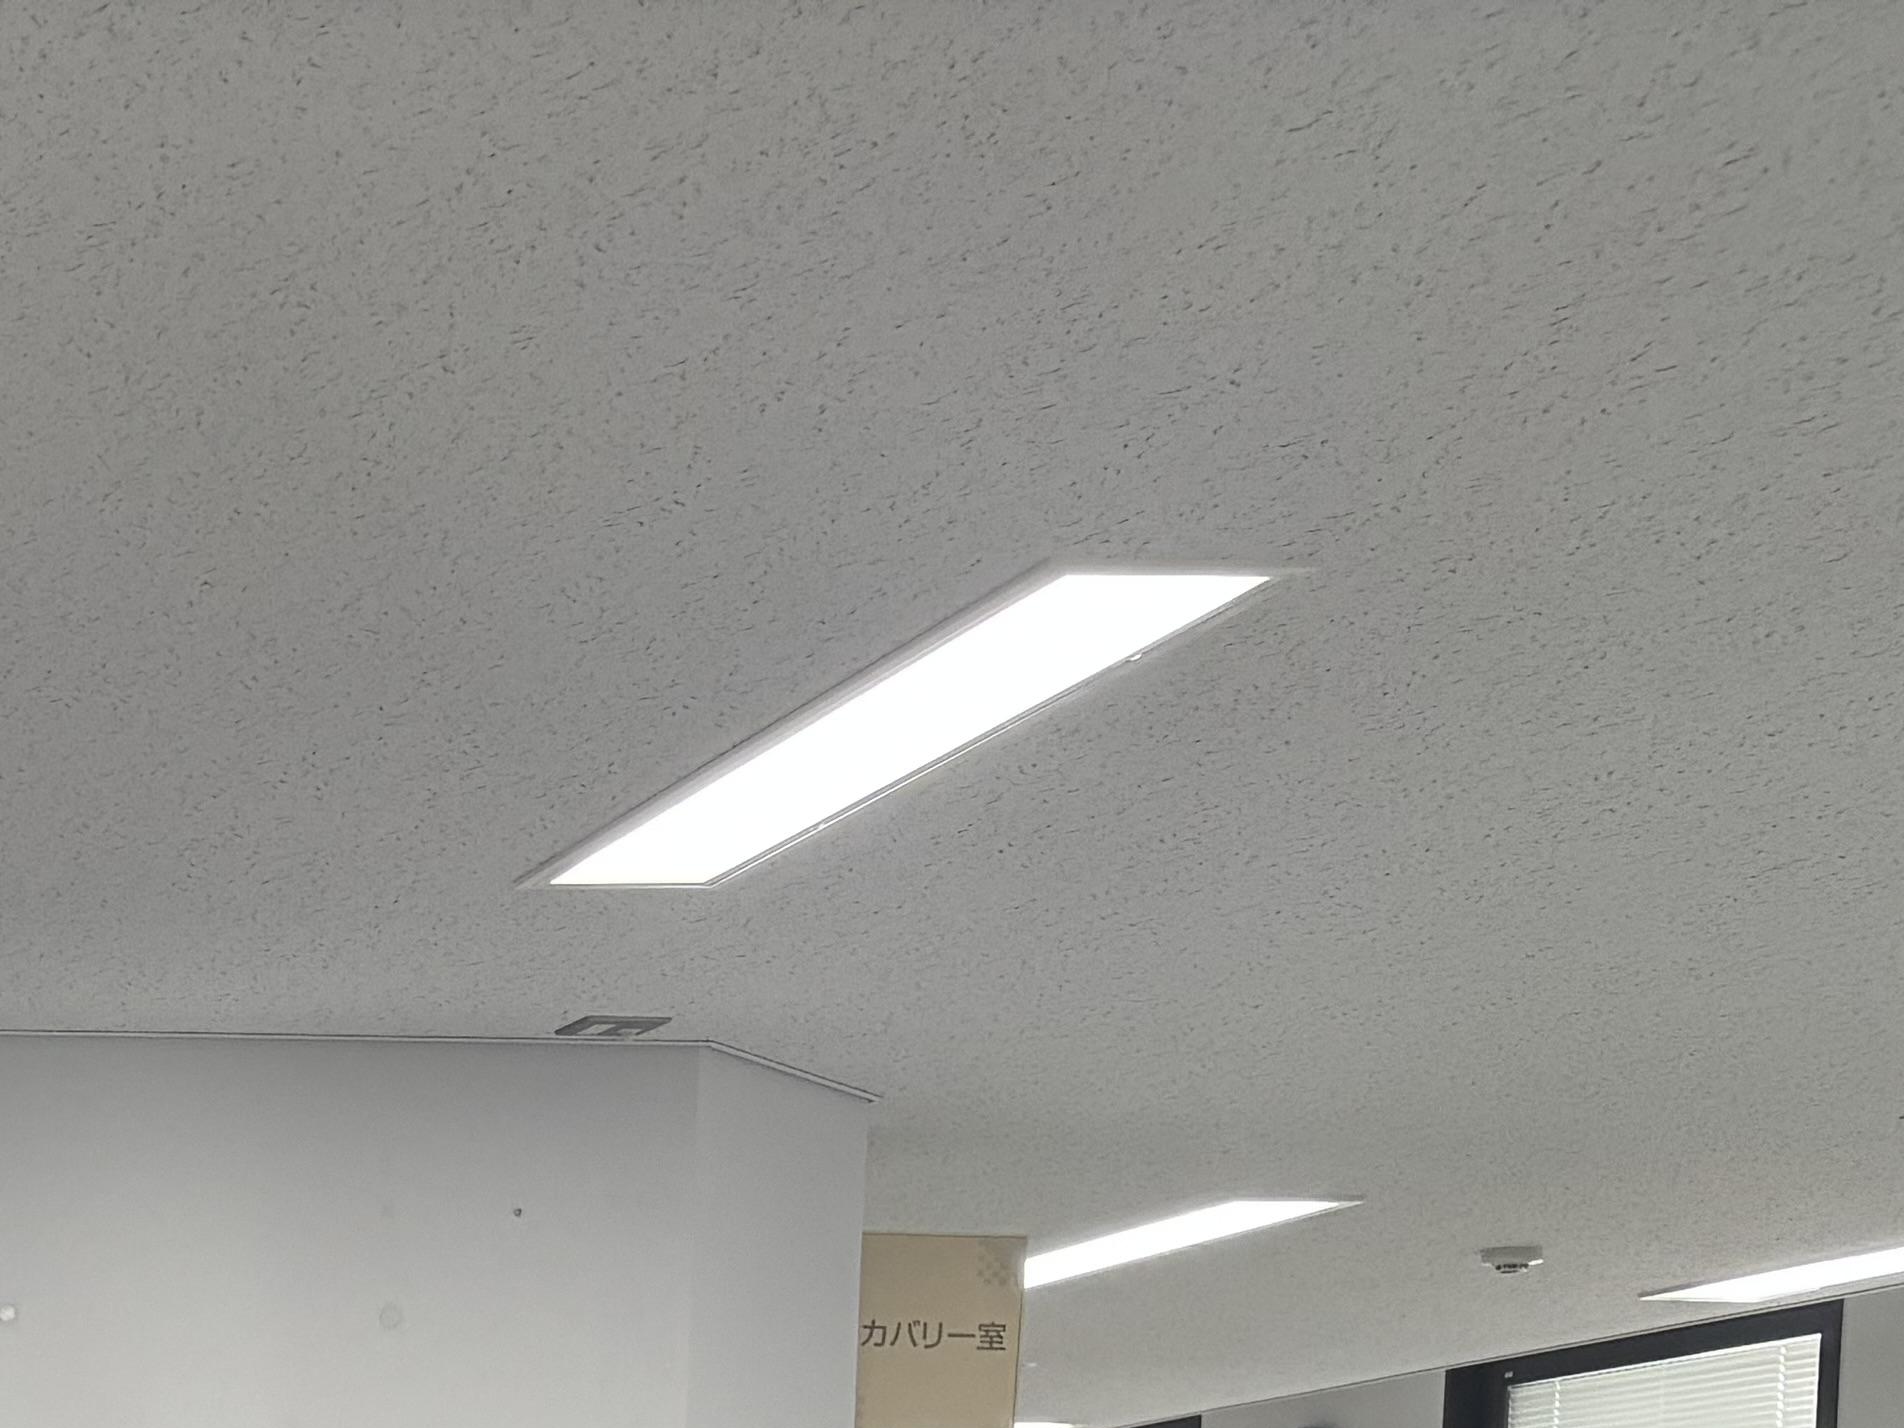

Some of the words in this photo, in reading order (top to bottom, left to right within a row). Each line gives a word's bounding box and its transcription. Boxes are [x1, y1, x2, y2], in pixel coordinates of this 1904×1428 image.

[860, 1320, 1007, 1351] カバリー室
